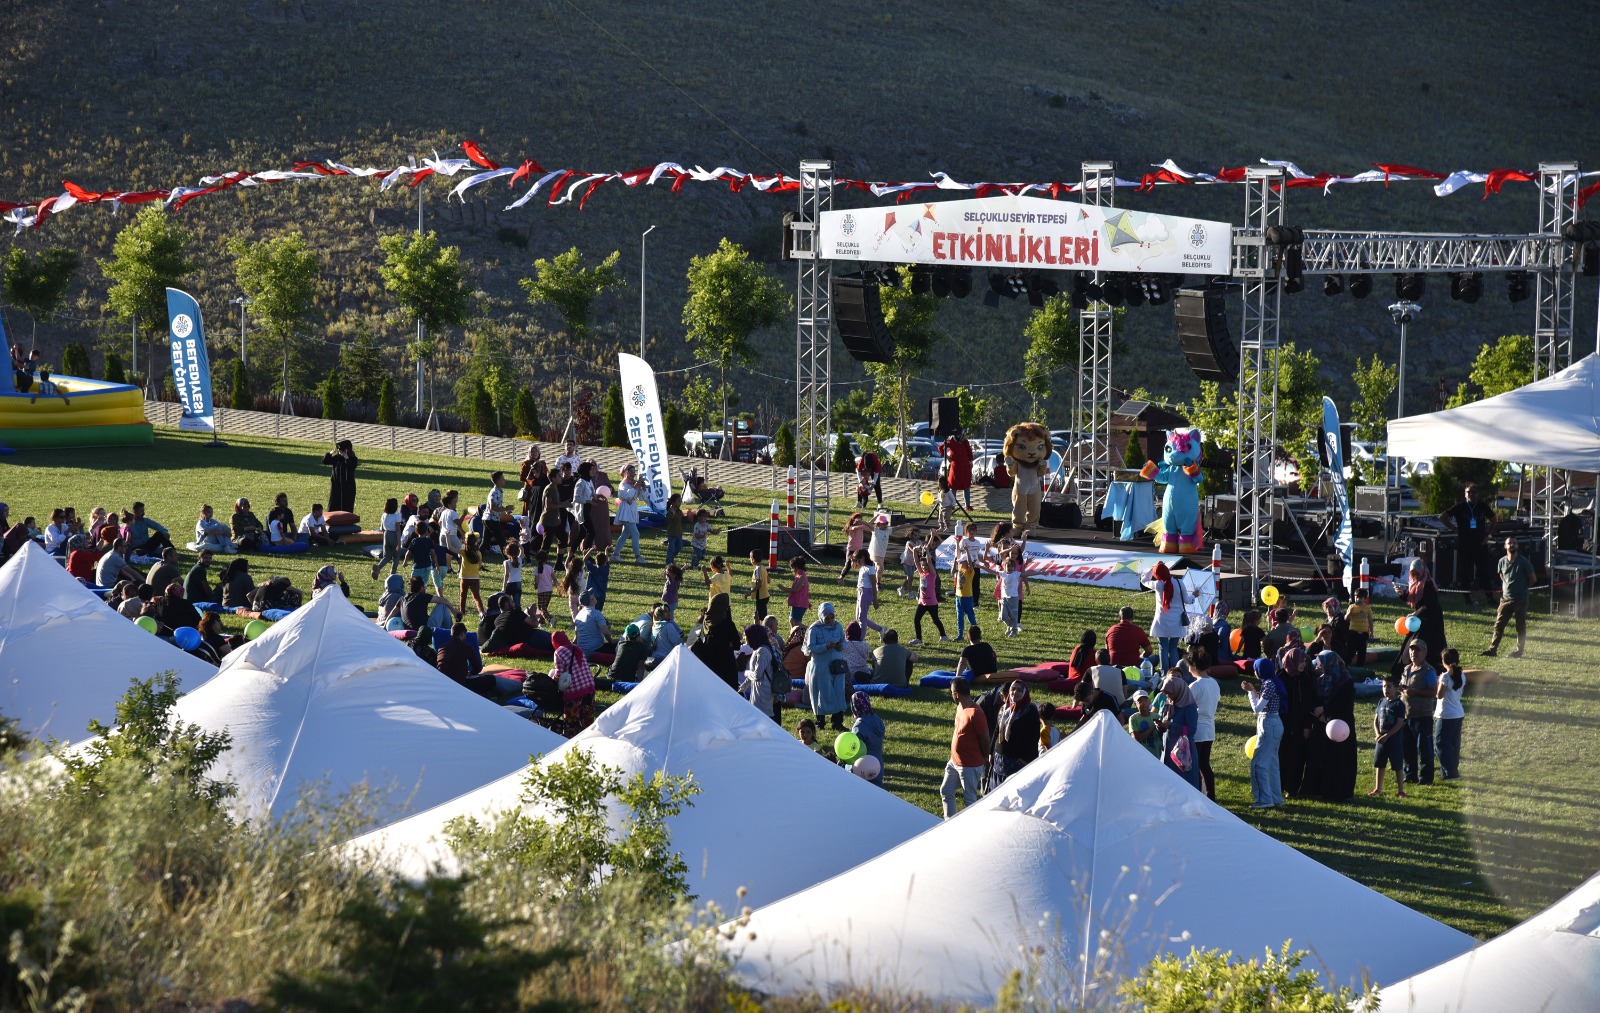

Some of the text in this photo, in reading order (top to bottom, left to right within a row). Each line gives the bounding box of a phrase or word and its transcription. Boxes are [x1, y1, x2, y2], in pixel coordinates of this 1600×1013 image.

[964, 211, 1068, 224] SELÇUKLU SEYİR TEPESİ
[932, 226, 1100, 266] ETKİNLİKLERİ
[1183, 253, 1211, 261] SELÇUKLU
[1181, 261, 1213, 269] BELEDİYESİ
